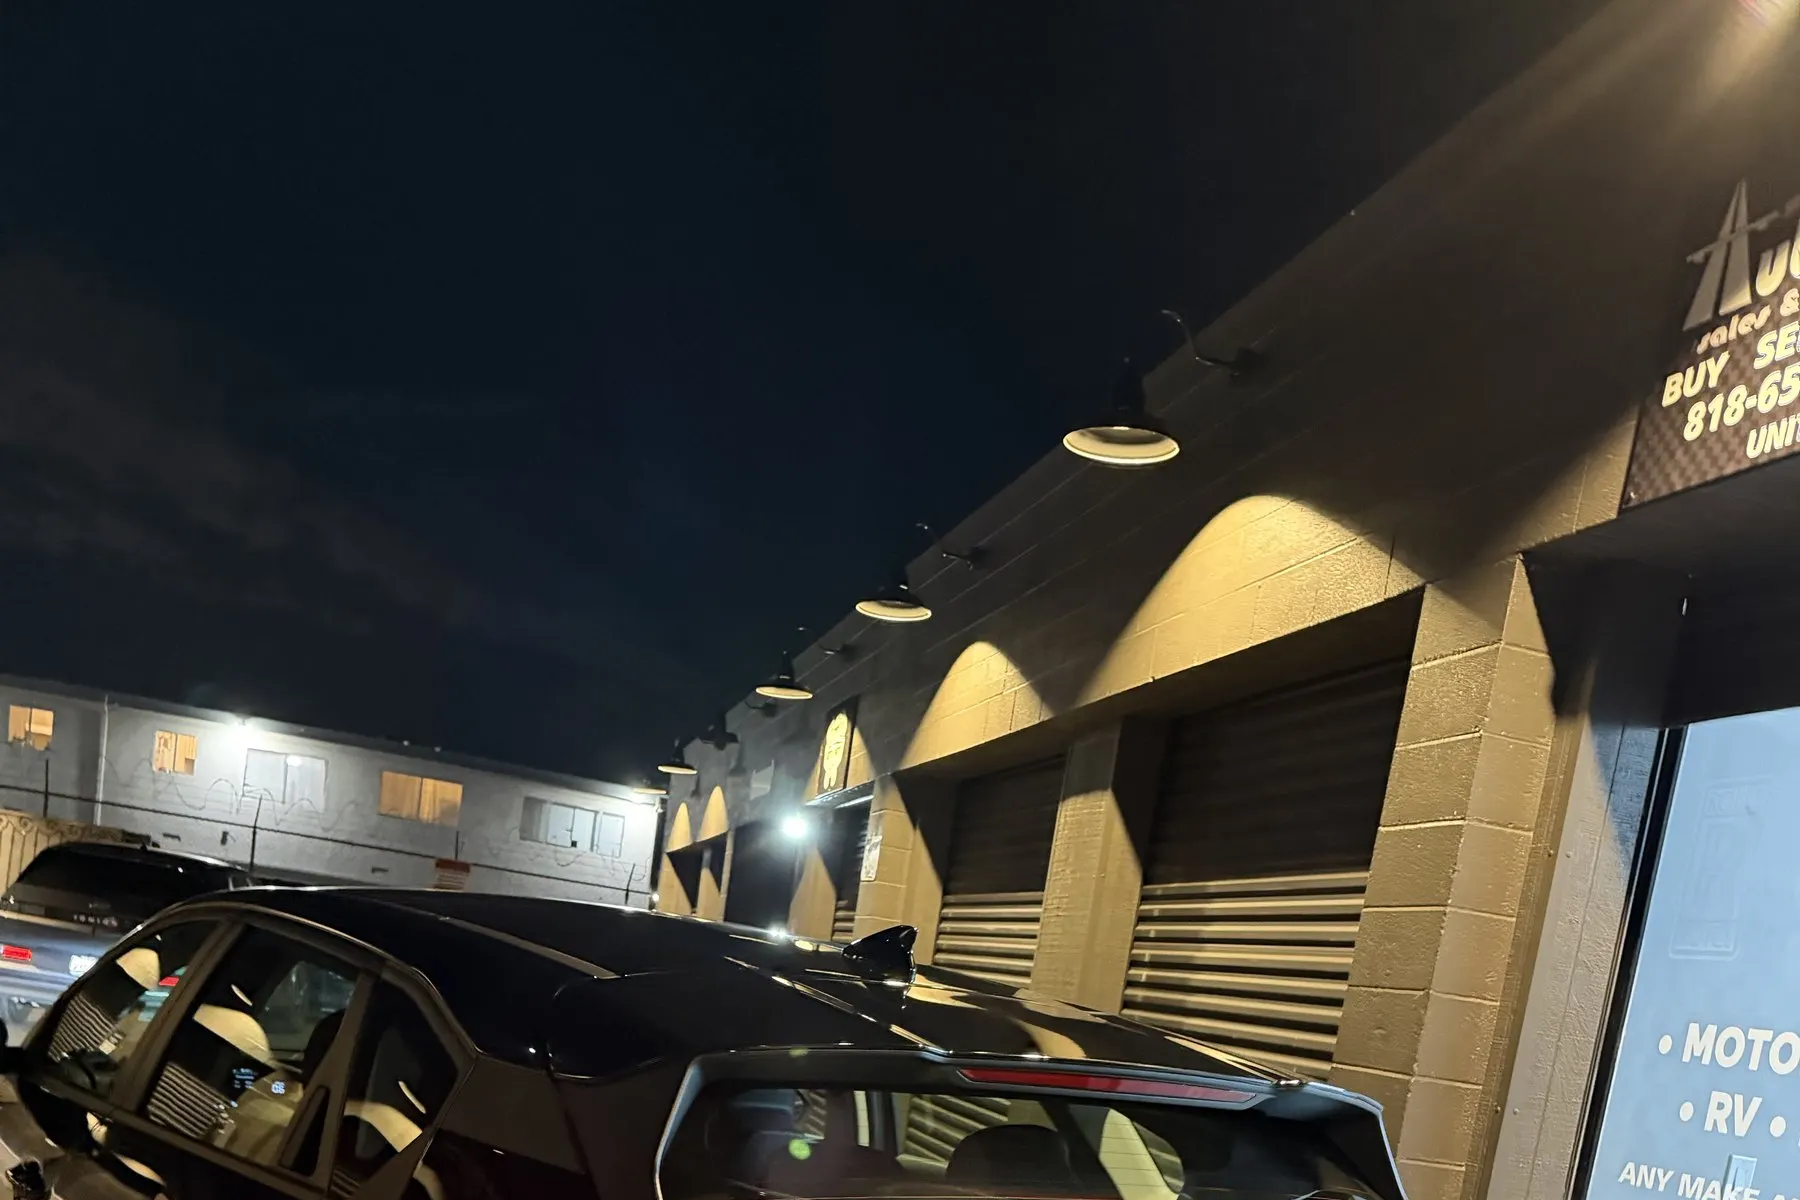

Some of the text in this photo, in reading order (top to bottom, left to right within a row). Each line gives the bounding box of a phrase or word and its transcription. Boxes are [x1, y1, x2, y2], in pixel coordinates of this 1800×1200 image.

[1696, 304, 1772, 355] sales
[1661, 320, 1800, 408] BUY SE
[1683, 361, 1800, 442] 818-65
[1746, 412, 1800, 459] UNI
[1704, 1090, 1763, 1137] RV
[1618, 1161, 1675, 1192] ANY
